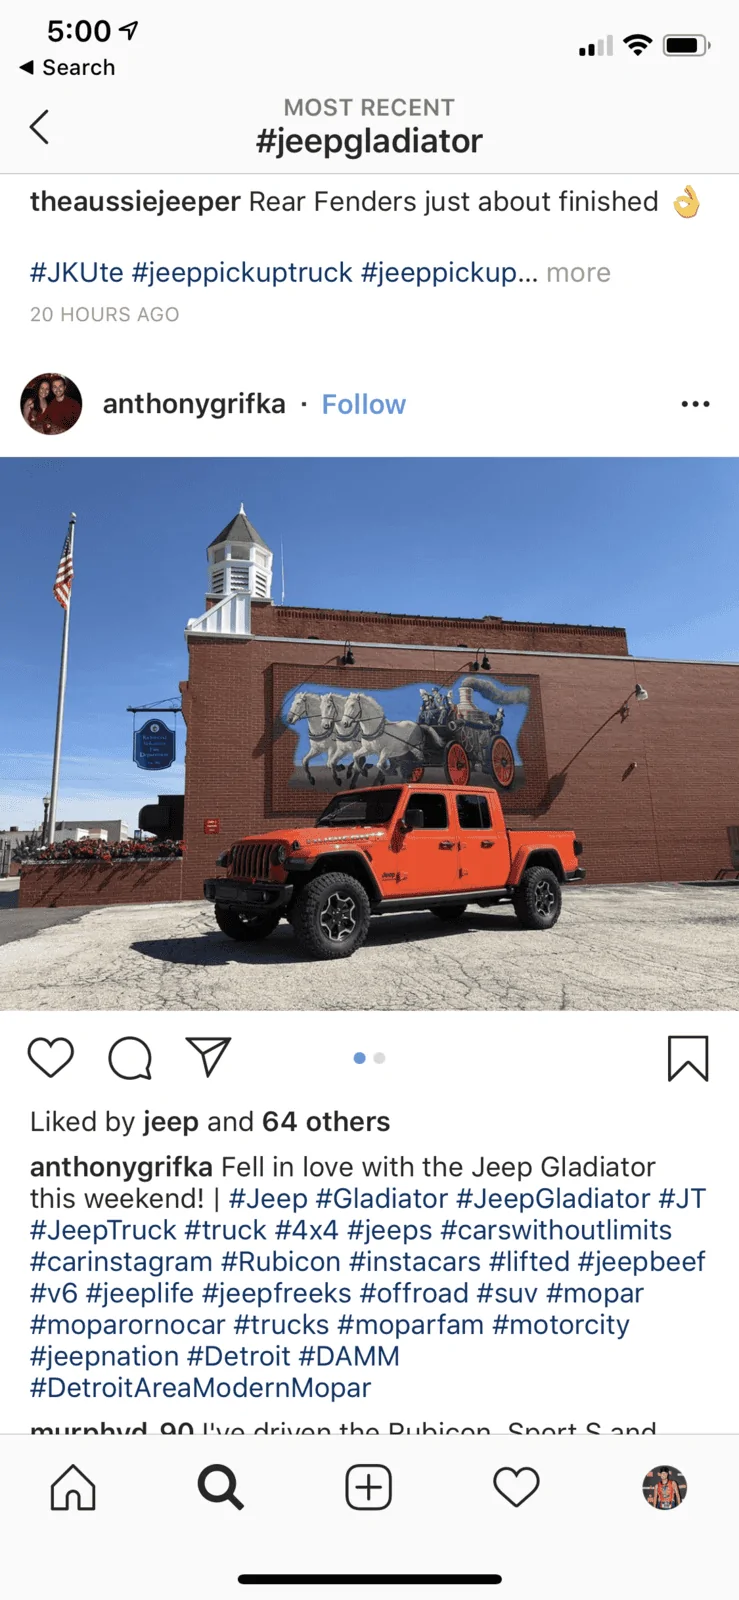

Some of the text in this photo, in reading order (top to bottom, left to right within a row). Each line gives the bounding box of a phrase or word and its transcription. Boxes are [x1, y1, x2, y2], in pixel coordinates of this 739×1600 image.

[48, 19, 111, 42] 5:00
[43, 58, 115, 76] Search
[285, 98, 455, 117] MOST RECENT
[256, 126, 483, 160] #jeepgladiator
[30, 189, 658, 216] theaussiejeeper Rear Fenders just about finished
[30, 262, 123, 283] #JKUte
[132, 261, 353, 287] #jeeppickuptruck
[548, 267, 610, 282] more
[31, 307, 179, 322] 20 HOURS AGO
[103, 392, 406, 419] anthonygrifka Follow
[31, 1109, 390, 1137] Liked by jeep and 64 others
[30, 1155, 656, 1183] anthonygrifka Fell in love with the Jeep Gladiator
[30, 1187, 75, 1209] this
[84, 1187, 203, 1209] weekend!
[229, 1188, 307, 1213] #Jeep
[316, 1187, 448, 1209] #Gladiator
[456, 1187, 651, 1213] #JeepGladiator
[658, 1188, 706, 1209] #JT
[30, 1219, 672, 1245] #JeepTruck #truck #4x4 #jeeps #carswithoutlimits
[30, 1250, 706, 1277] #carinstagram #Rubicon #instacars #lifted #jeepbeef
[30, 1282, 644, 1308] #v6 #jeeplife #jeepfreeks #offroad #suv #mopar
[30, 1313, 630, 1340] #moparornocar #trucks #moparfam #motorcity
[30, 1345, 398, 1371] #jeepnation #Detroit #DAMM
[30, 1376, 372, 1402] #DetroitAreaModernMopar
